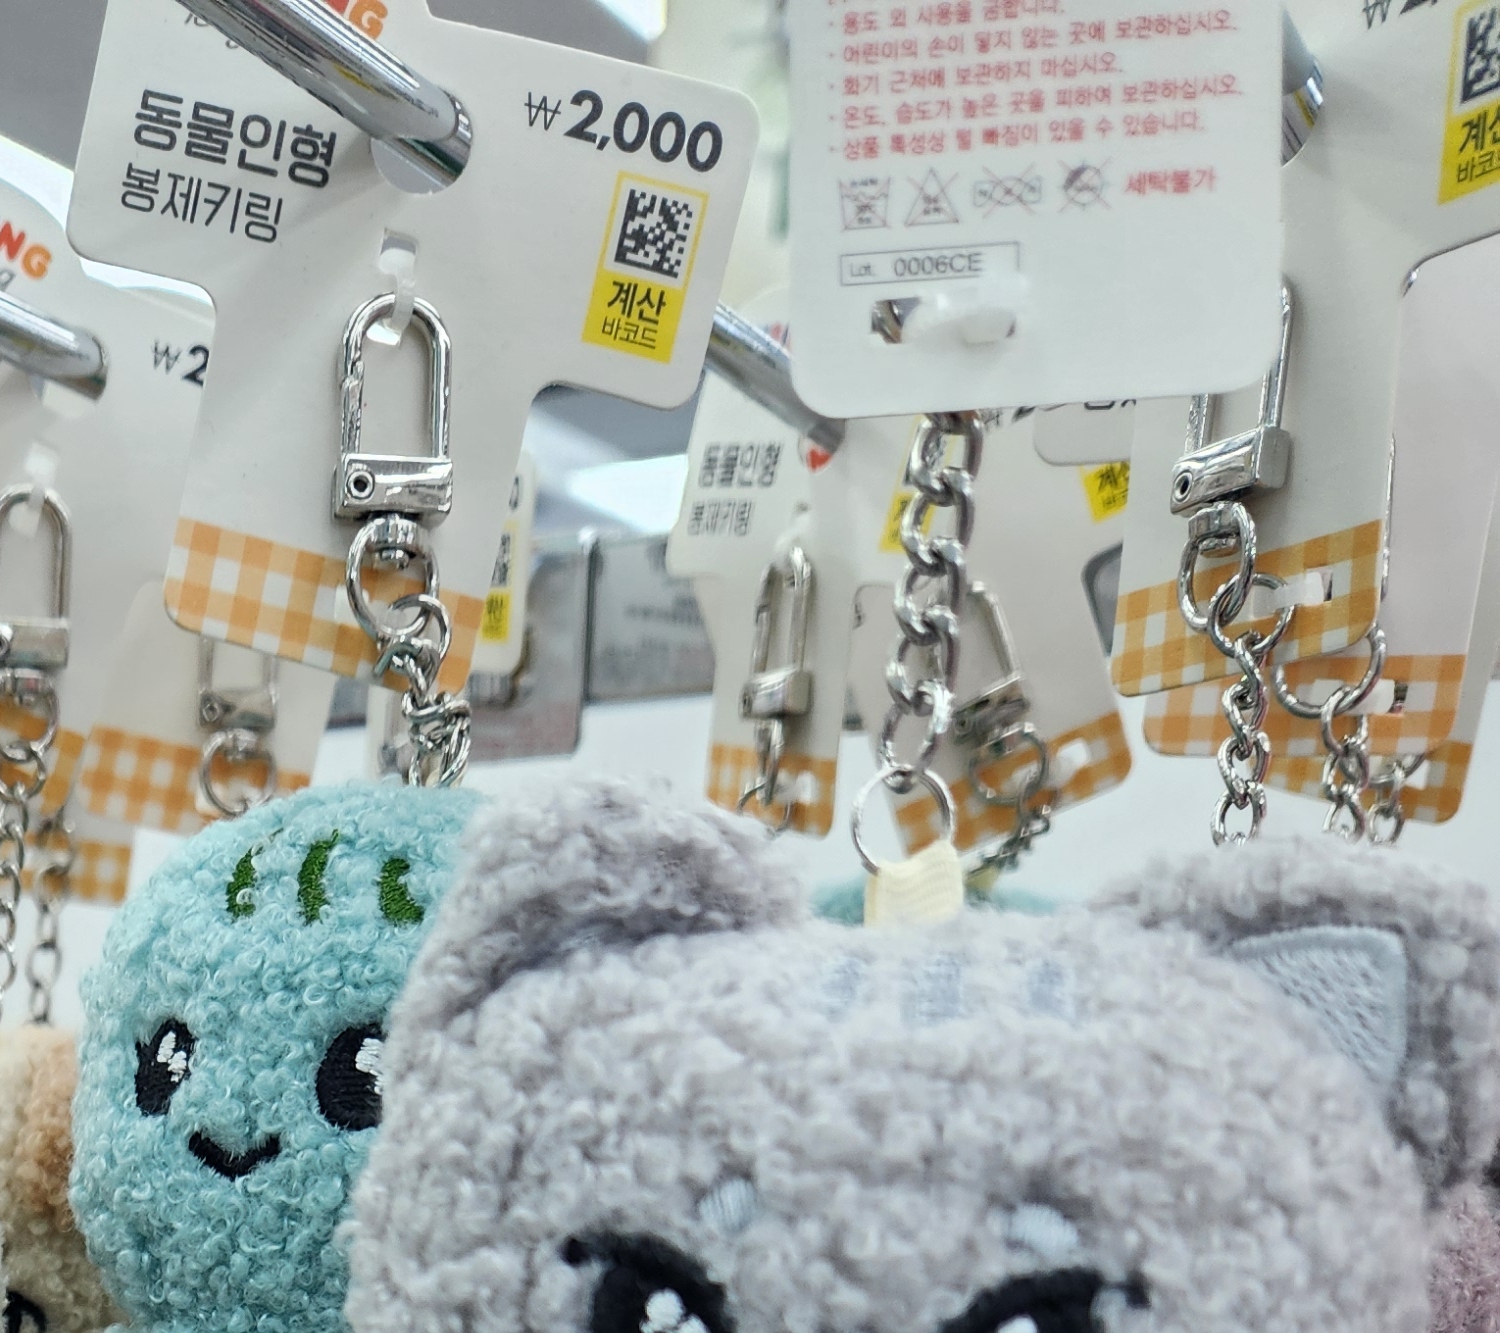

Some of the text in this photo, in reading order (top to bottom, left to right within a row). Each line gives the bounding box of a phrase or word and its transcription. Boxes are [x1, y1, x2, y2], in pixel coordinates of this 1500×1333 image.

[844, 38, 918, 64] 어린이의
[929, 34, 964, 58] 손이
[1070, 20, 1105, 44] 곳에
[1116, 10, 1237, 39] 보관하십시오.
[844, 52, 1123, 96] 화기 근처에 보관하지 마십시오.
[896, 99, 951, 124] 습도가
[1010, 88, 1045, 113] 곳을
[1056, 84, 1111, 107] 피하여
[1122, 74, 1243, 103] 보관하십시오.
[134, 89, 337, 188] 동물인형
[524, 89, 723, 173] ₩2,000
[845, 136, 878, 161] 상품
[1049, 117, 1085, 142] 있을
[1096, 115, 1114, 140] 수
[1123, 110, 1204, 137] 있습니다.
[1126, 165, 1216, 196] 세탁불가
[1457, 150, 1500, 184] 바코
[120, 162, 283, 243] 봉제키링
[607, 280, 666, 325] 계산
[602, 316, 658, 350] 바코드
